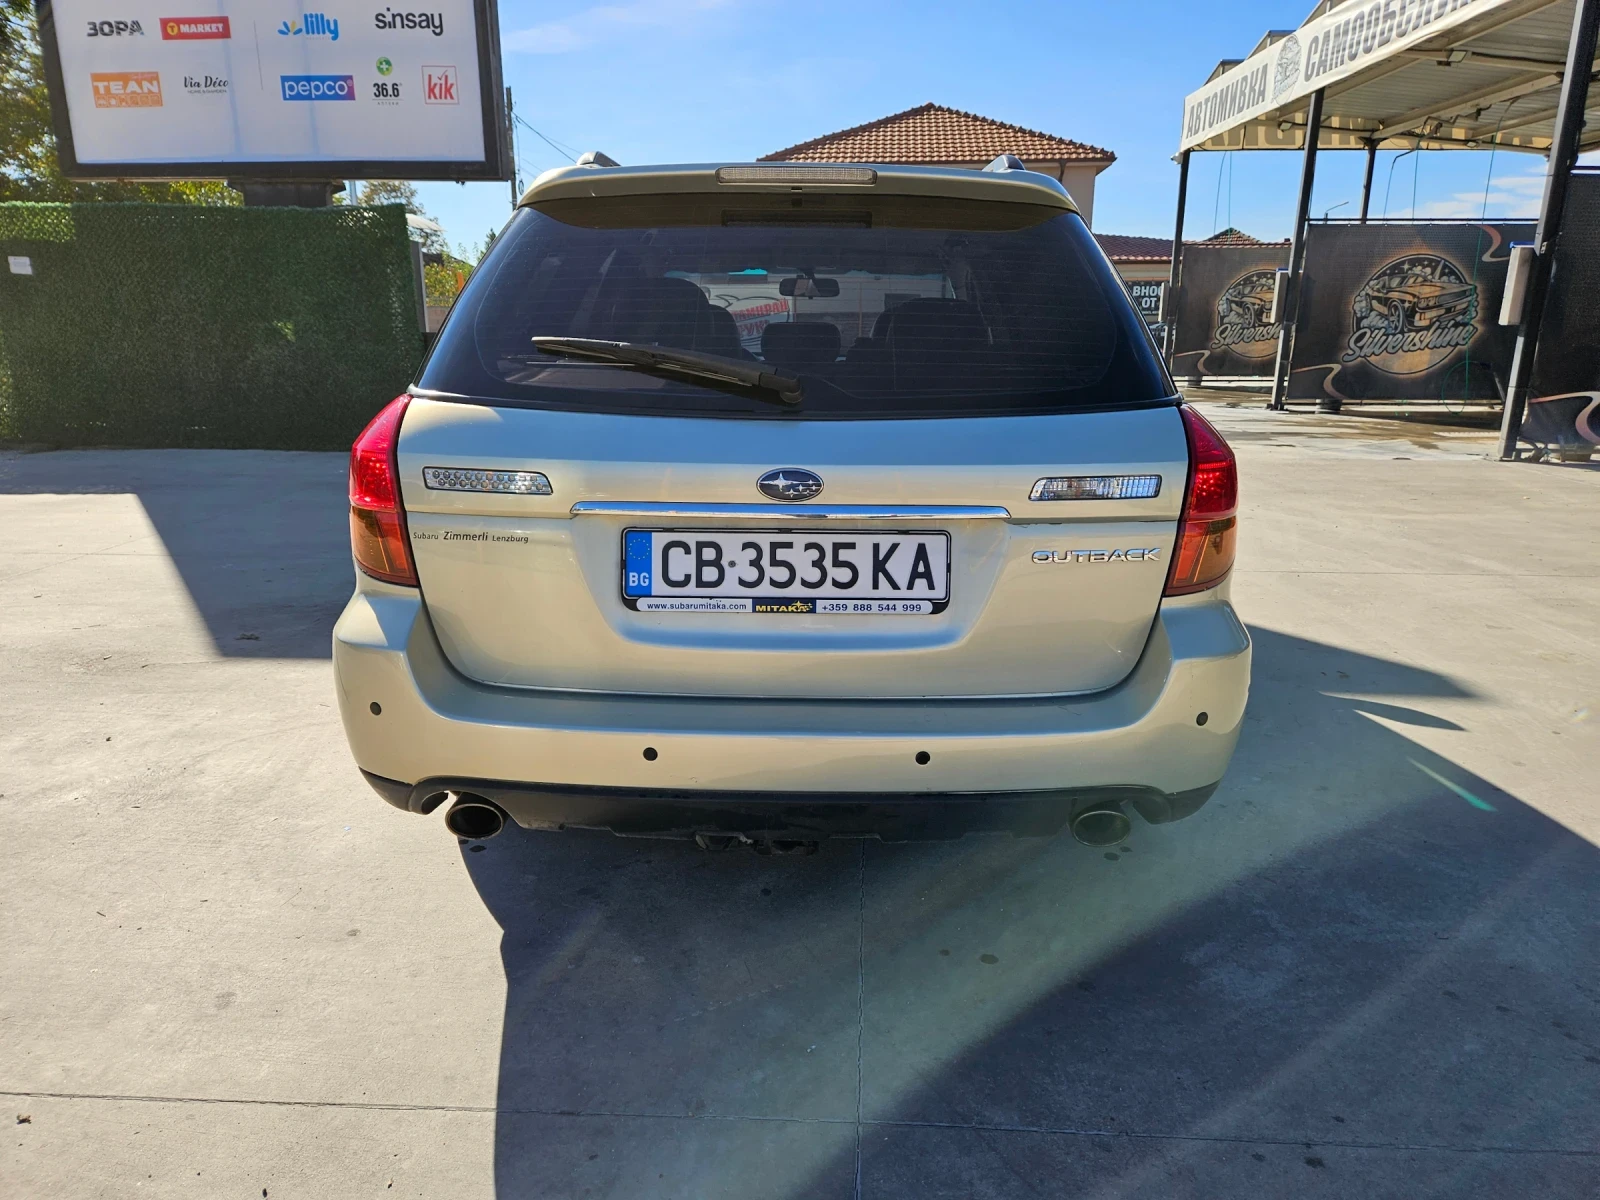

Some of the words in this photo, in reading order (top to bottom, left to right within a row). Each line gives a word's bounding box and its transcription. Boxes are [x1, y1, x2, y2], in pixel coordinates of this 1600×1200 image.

[180, 23, 223, 33] MARKET
[303, 13, 339, 41] lilly
[375, 7, 444, 37] sinsay
[1185, 63, 1268, 139] АВТОМИВКА
[1304, 0, 1475, 83] САМООБСЛ
[93, 80, 159, 94] TEAN
[184, 75, 202, 88] Via
[204, 75, 229, 88] Déco
[284, 81, 348, 99] pepco
[373, 82, 400, 98] 36.6
[427, 70, 455, 100] kik
[1141, 297, 1157, 308] ОТ
[1211, 322, 1282, 349] Silversh
[1342, 319, 1478, 362] Silvershine
[413, 532, 439, 540] Subaru
[443, 531, 489, 541] Zimmerli
[492, 535, 529, 544] Lenzburg
[1031, 547, 1161, 564] OUTBACK
[661, 540, 726, 589] CB
[738, 541, 860, 590] 3535
[872, 542, 936, 591] KA
[628, 572, 650, 587] BG
[646, 600, 747, 611] www.subarumitaka.com
[822, 603, 848, 612] +359
[853, 603, 873, 612] 888
[877, 603, 897, 612] 544
[902, 603, 922, 612] 999
